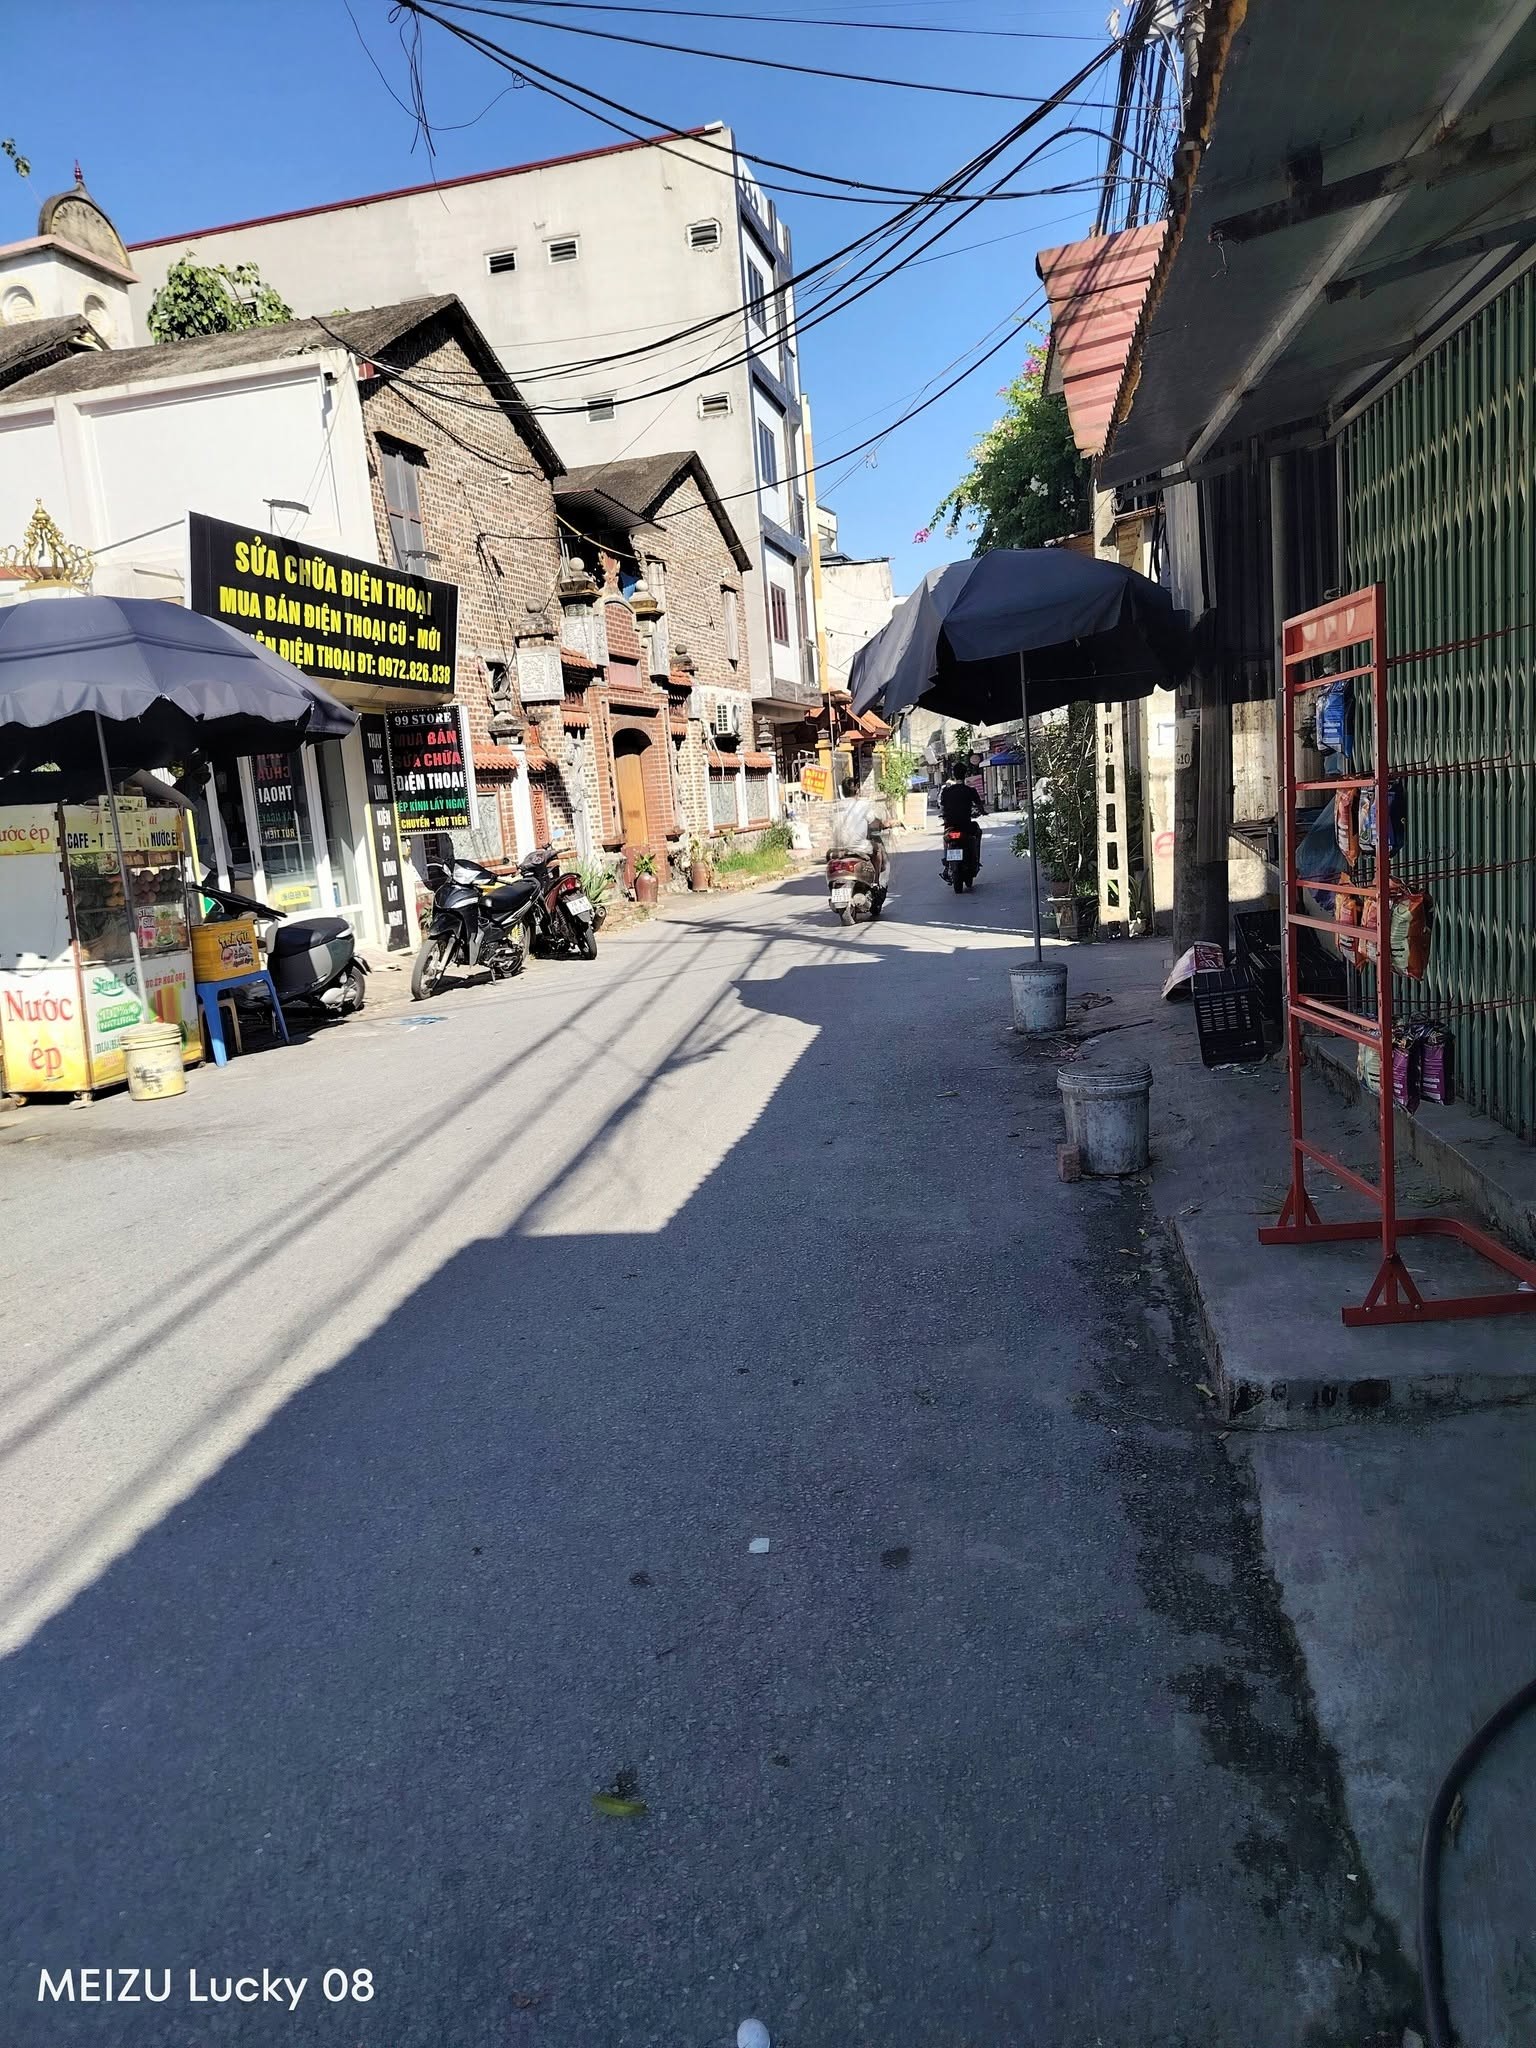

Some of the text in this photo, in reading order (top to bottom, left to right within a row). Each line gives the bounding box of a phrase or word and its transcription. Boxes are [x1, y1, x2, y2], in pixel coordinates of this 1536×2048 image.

[235, 536, 432, 620] SỬA CHỮA ĐIỆN THOẠI
[219, 585, 262, 619] MUA
[265, 593, 301, 627] BÁN
[303, 603, 342, 636] ĐIỆN
[344, 612, 386, 646] THOẠI
[389, 620, 407, 646] CŨ
[417, 626, 441, 652] MỚI
[279, 636, 314, 669] ĐIỆN
[316, 644, 355, 676] THOẠI
[357, 652, 376, 675] ĐT:
[378, 655, 451, 685] 0972.826.838
[394, 712, 452, 726] 99 STORE
[427, 728, 457, 745] BÁN
[423, 749, 462, 767] CHỮA
[396, 771, 465, 795] ĐIỆN THOẠI
[398, 796, 466, 812] ÉP KÍNH LẤY NGAY
[435, 815, 450, 827] RÚT
[29, 822, 50, 844] ép
[67, 832, 89, 849] CAFE
[150, 829, 171, 847] NƯỚC
[4, 989, 74, 1021] Nước
[30, 1039, 62, 1077] ép
